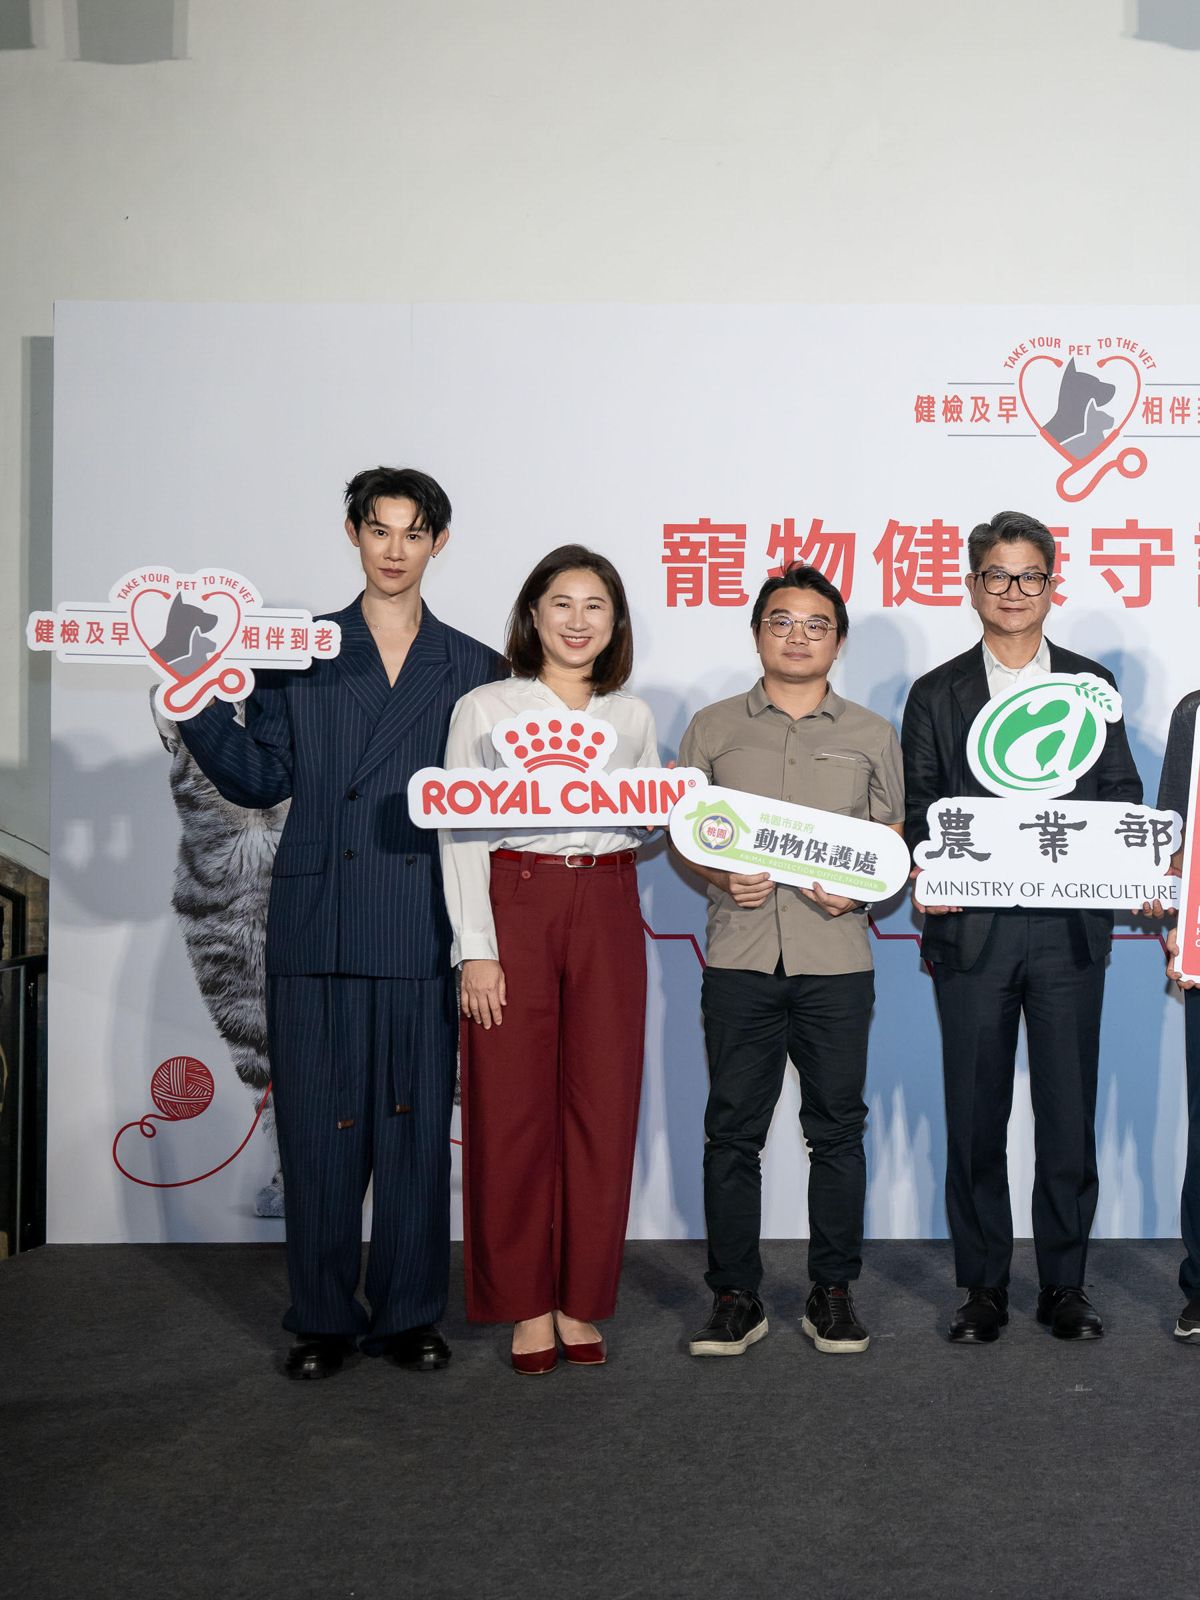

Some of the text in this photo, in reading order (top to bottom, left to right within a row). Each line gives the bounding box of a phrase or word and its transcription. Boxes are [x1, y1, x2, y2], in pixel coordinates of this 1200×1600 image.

[1004, 337, 1157, 370] TAKE YOUR PET TO THE VET
[914, 395, 1018, 423] 健檢及早
[117, 573, 255, 605] TAKE YOUR PET TO THE VET
[34, 619, 130, 645] 健檢及早
[241, 626, 333, 651] 相伴到老
[422, 780, 551, 815] ROYAL
[753, 828, 879, 876] 動物保護處
[925, 807, 1174, 867] 農業部
[925, 881, 1178, 900] MINISTRY OF AGRICULTURE
